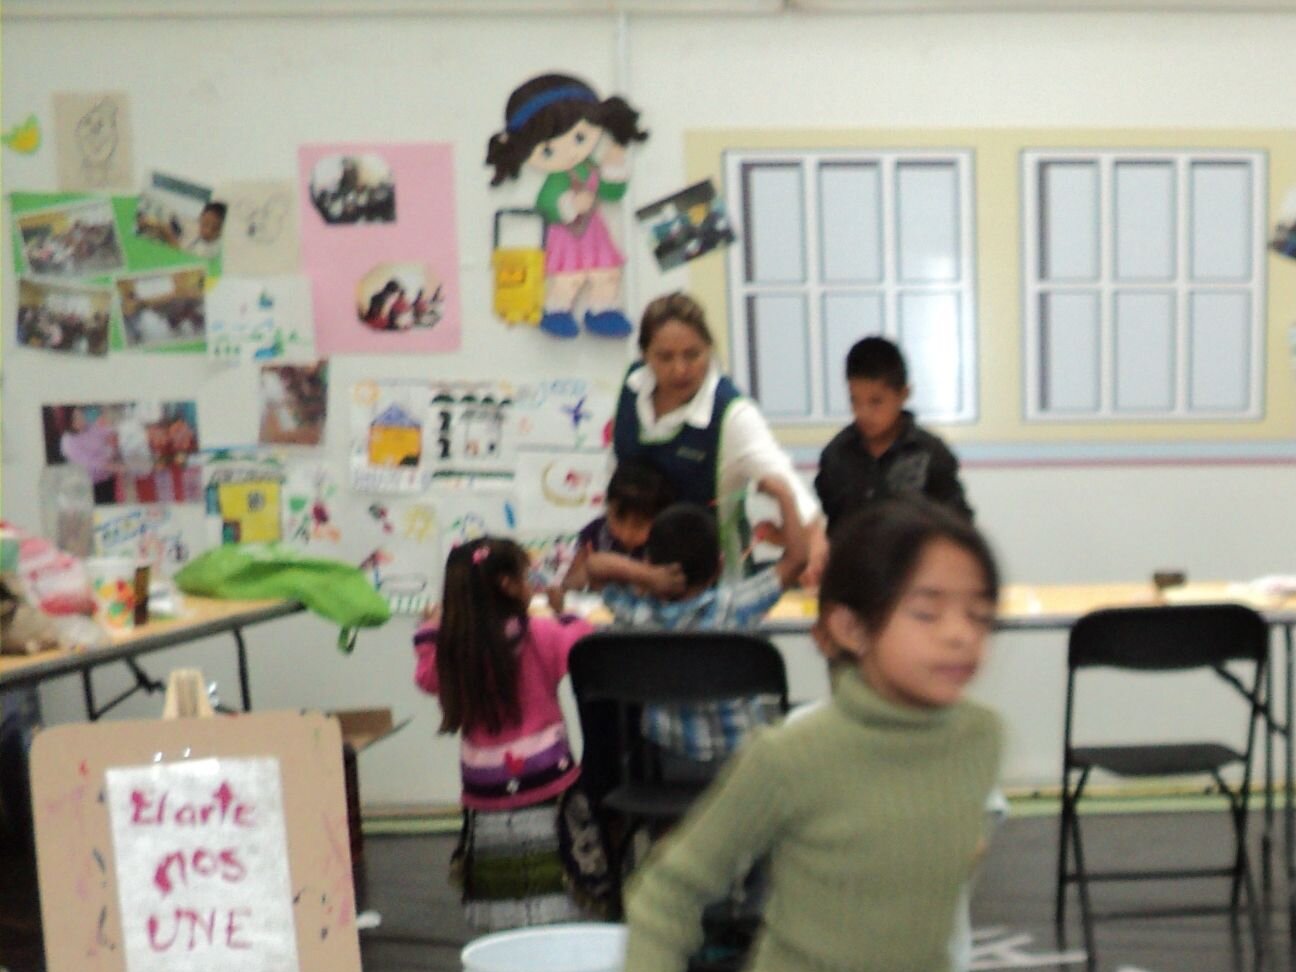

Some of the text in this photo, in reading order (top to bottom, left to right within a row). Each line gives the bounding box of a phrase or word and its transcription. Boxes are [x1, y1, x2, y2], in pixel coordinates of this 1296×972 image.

[130, 781, 255, 827] El arte
[154, 848, 246, 896] nos
[146, 907, 252, 952] UNE
